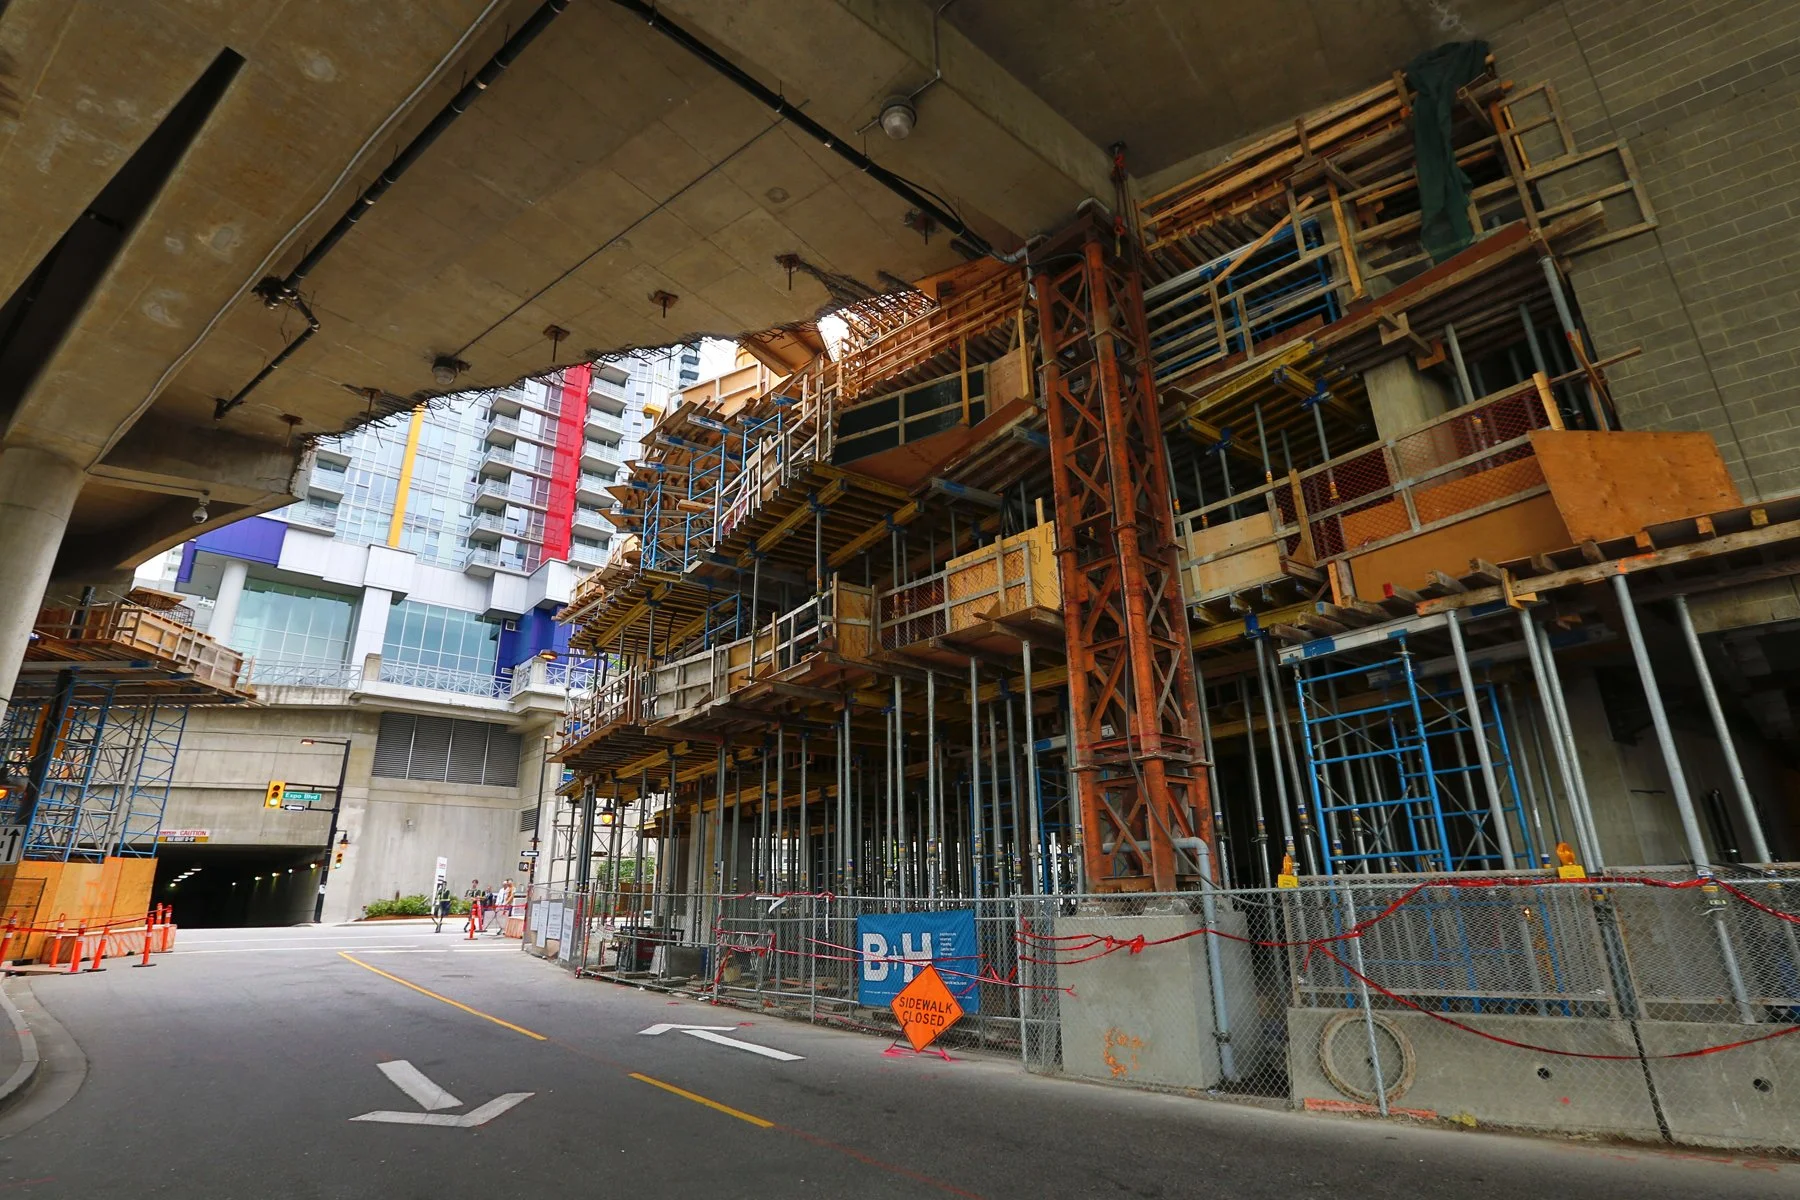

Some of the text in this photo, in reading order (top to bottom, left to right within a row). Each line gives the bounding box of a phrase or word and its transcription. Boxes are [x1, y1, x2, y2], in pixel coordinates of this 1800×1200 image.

[862, 932, 933, 983] B+H
[898, 996, 953, 1014] SIDEWALK
[902, 1010, 945, 1027] CLOSED
